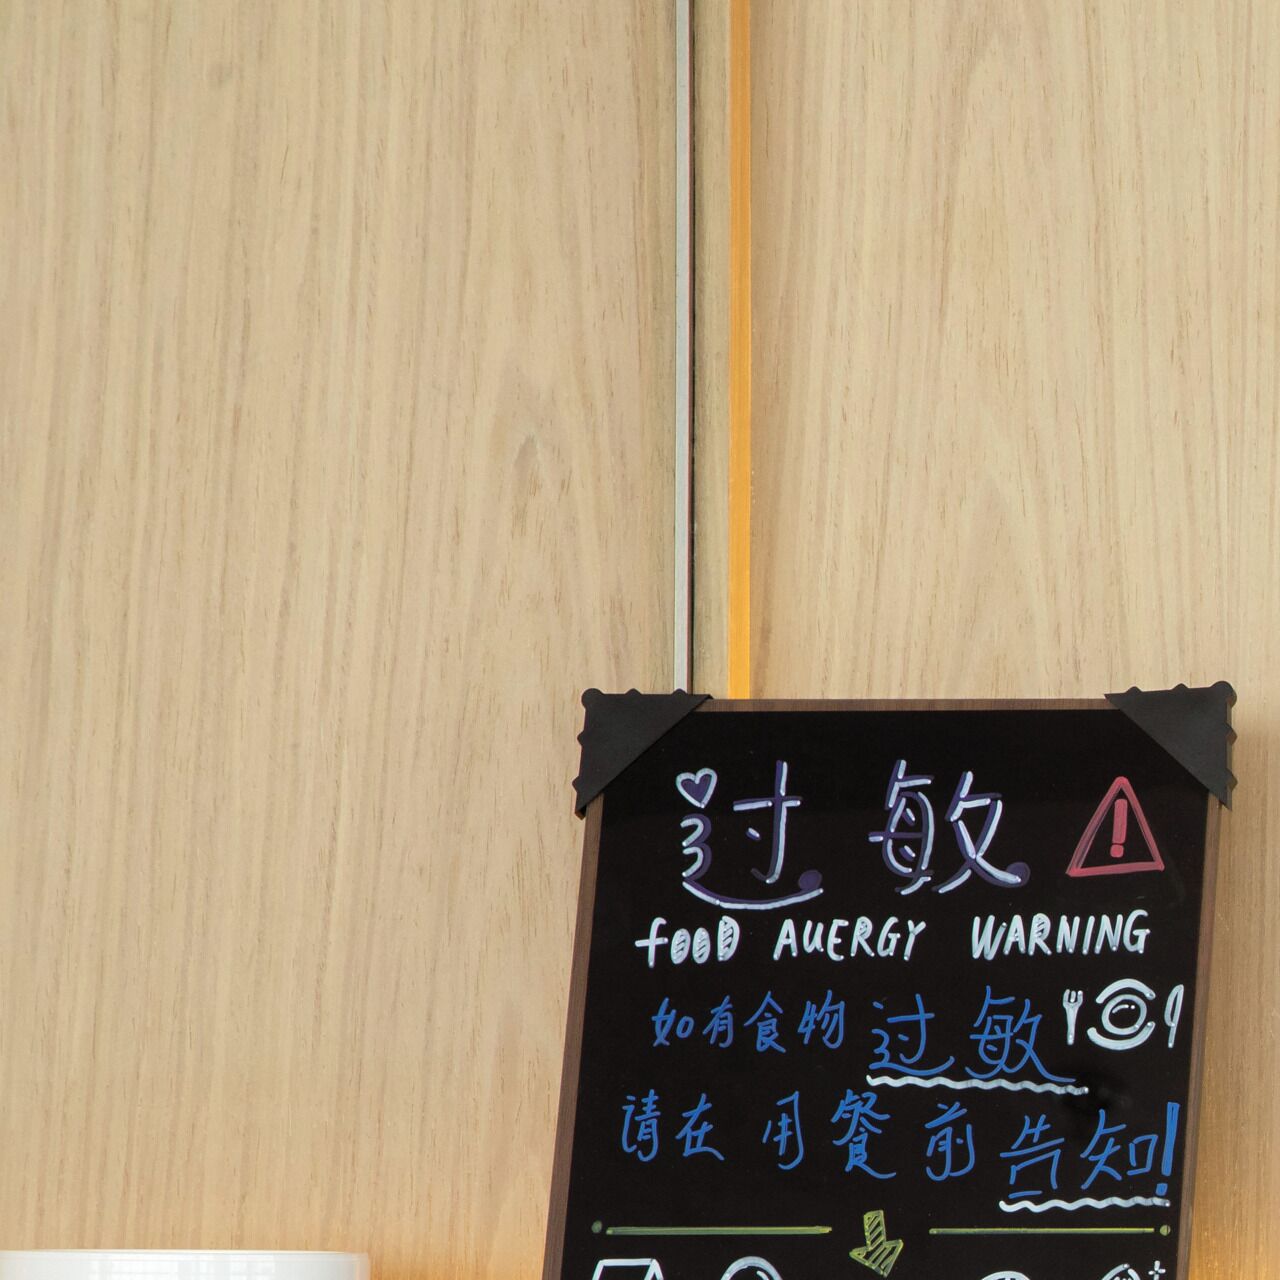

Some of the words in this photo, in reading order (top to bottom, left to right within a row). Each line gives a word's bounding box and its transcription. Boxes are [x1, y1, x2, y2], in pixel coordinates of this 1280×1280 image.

[677, 760, 1031, 910] 过敏
[972, 909, 1150, 960] WARNING
[651, 985, 1077, 1083] 如有食物过敏
